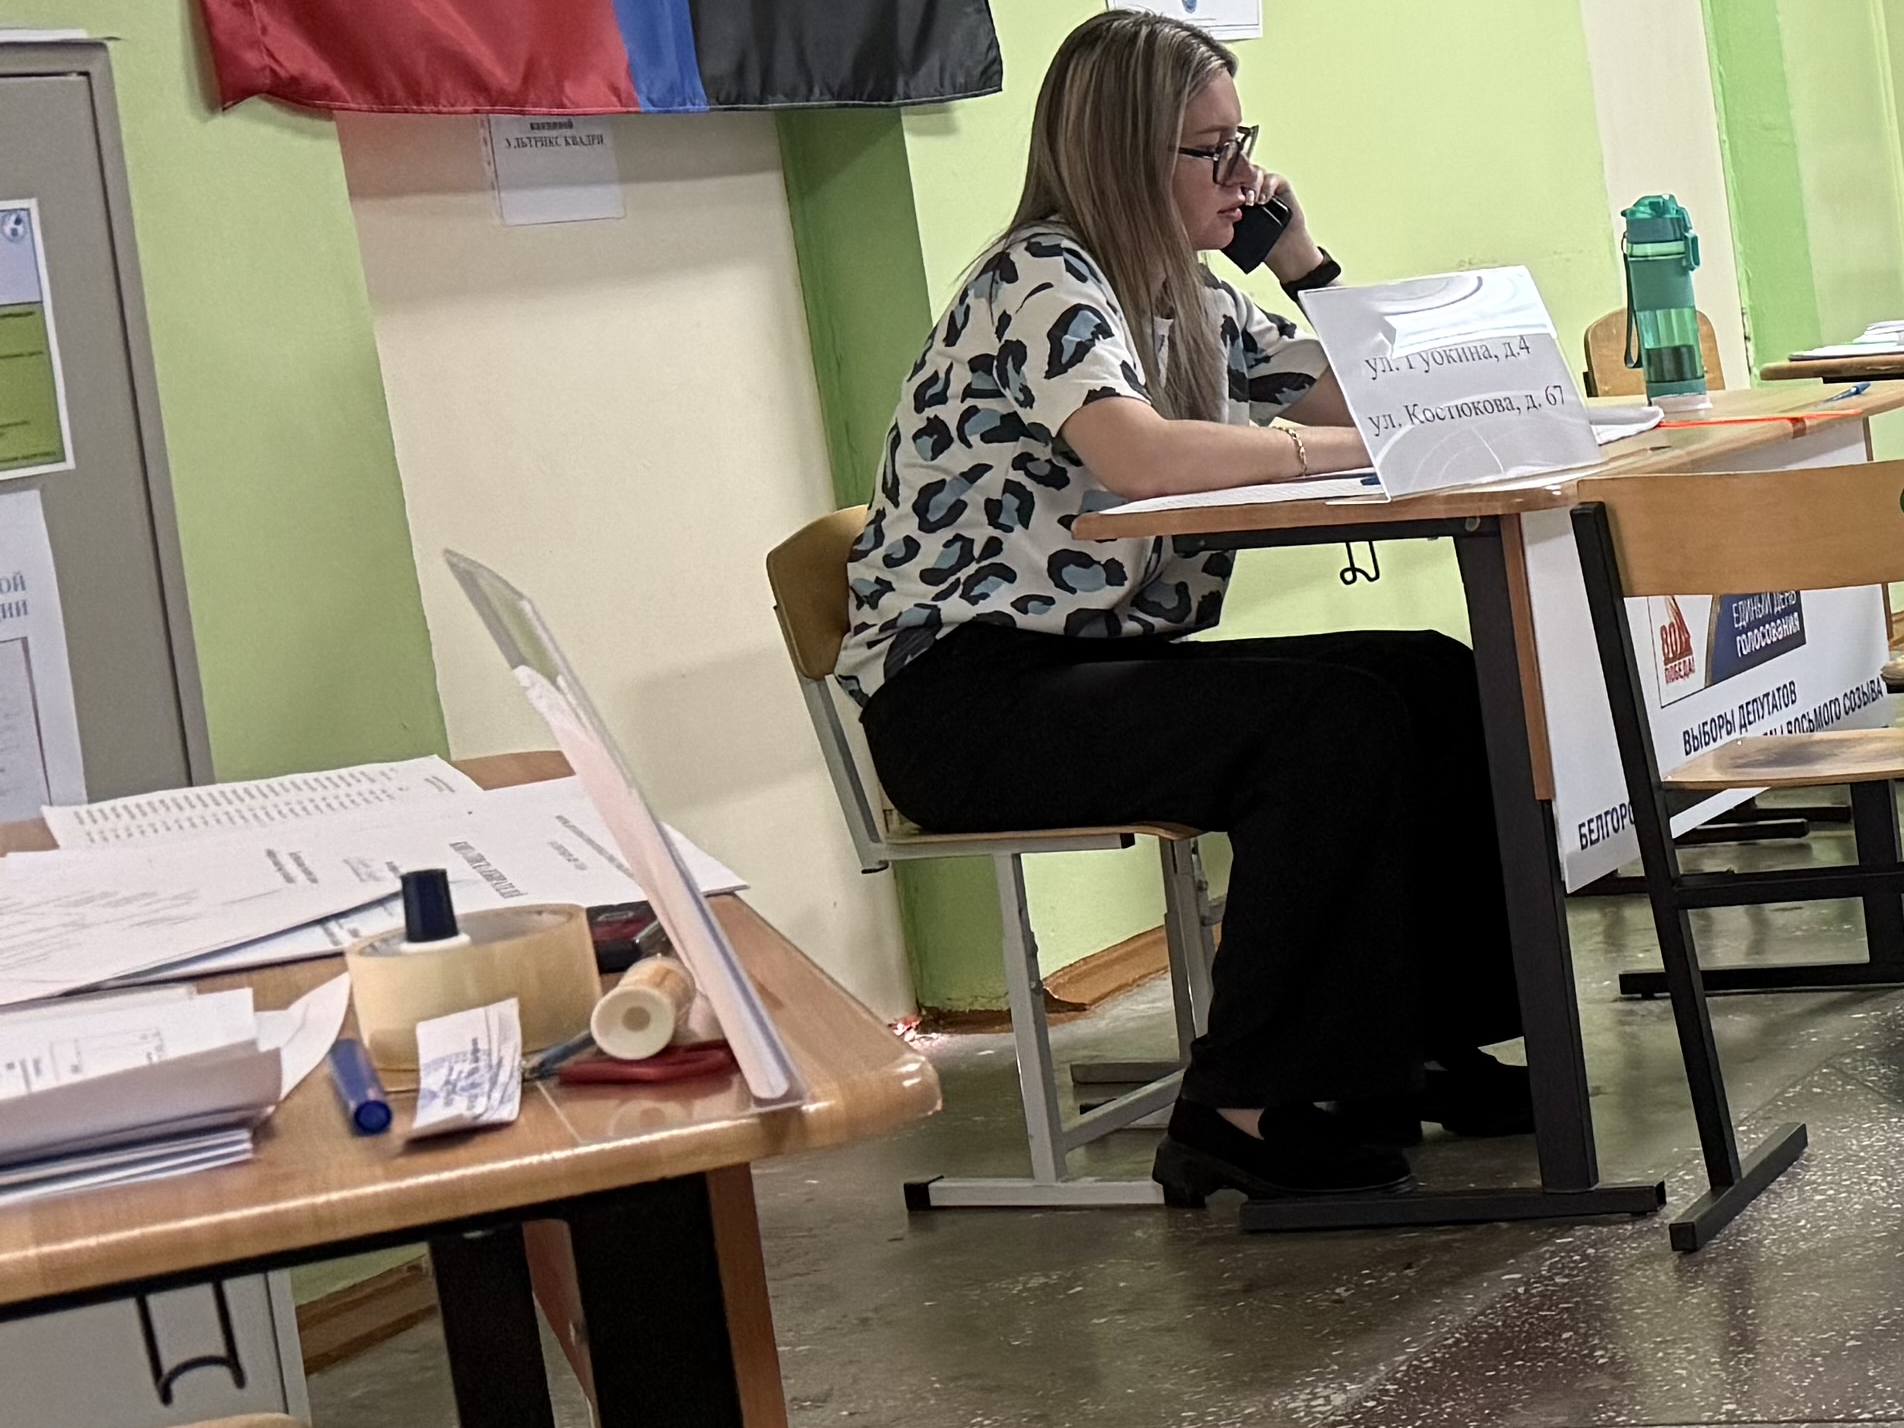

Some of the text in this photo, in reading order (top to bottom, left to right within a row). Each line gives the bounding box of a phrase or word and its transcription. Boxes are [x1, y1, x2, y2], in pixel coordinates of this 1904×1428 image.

[1368, 385, 1565, 437] ул. Костюкова, д. 67
[1683, 680, 1797, 756] ВЫБОРЫ ДЕПУТАТОВ
[1842, 677, 1884, 716] СОЗЫВА
